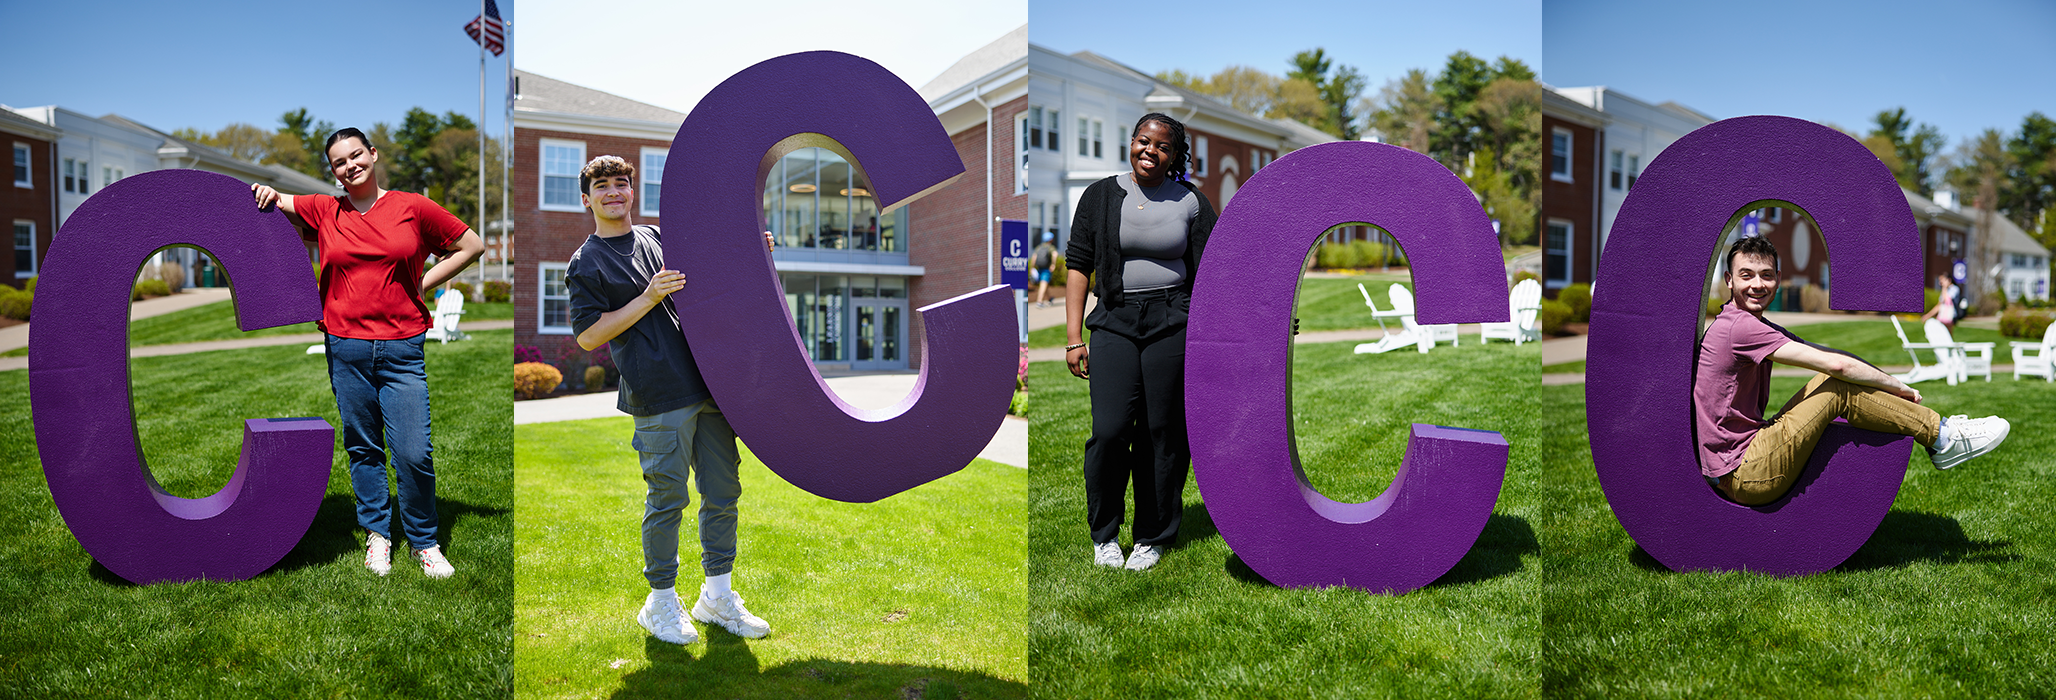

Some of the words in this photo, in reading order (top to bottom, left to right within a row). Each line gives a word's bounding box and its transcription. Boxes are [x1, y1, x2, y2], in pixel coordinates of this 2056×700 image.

[28, 168, 334, 585] C
[660, 50, 1019, 503] C
[1002, 257, 1027, 267] CURRY
[1010, 239, 1021, 257] C
[1185, 141, 1510, 594] C
[1585, 115, 1925, 576] C
